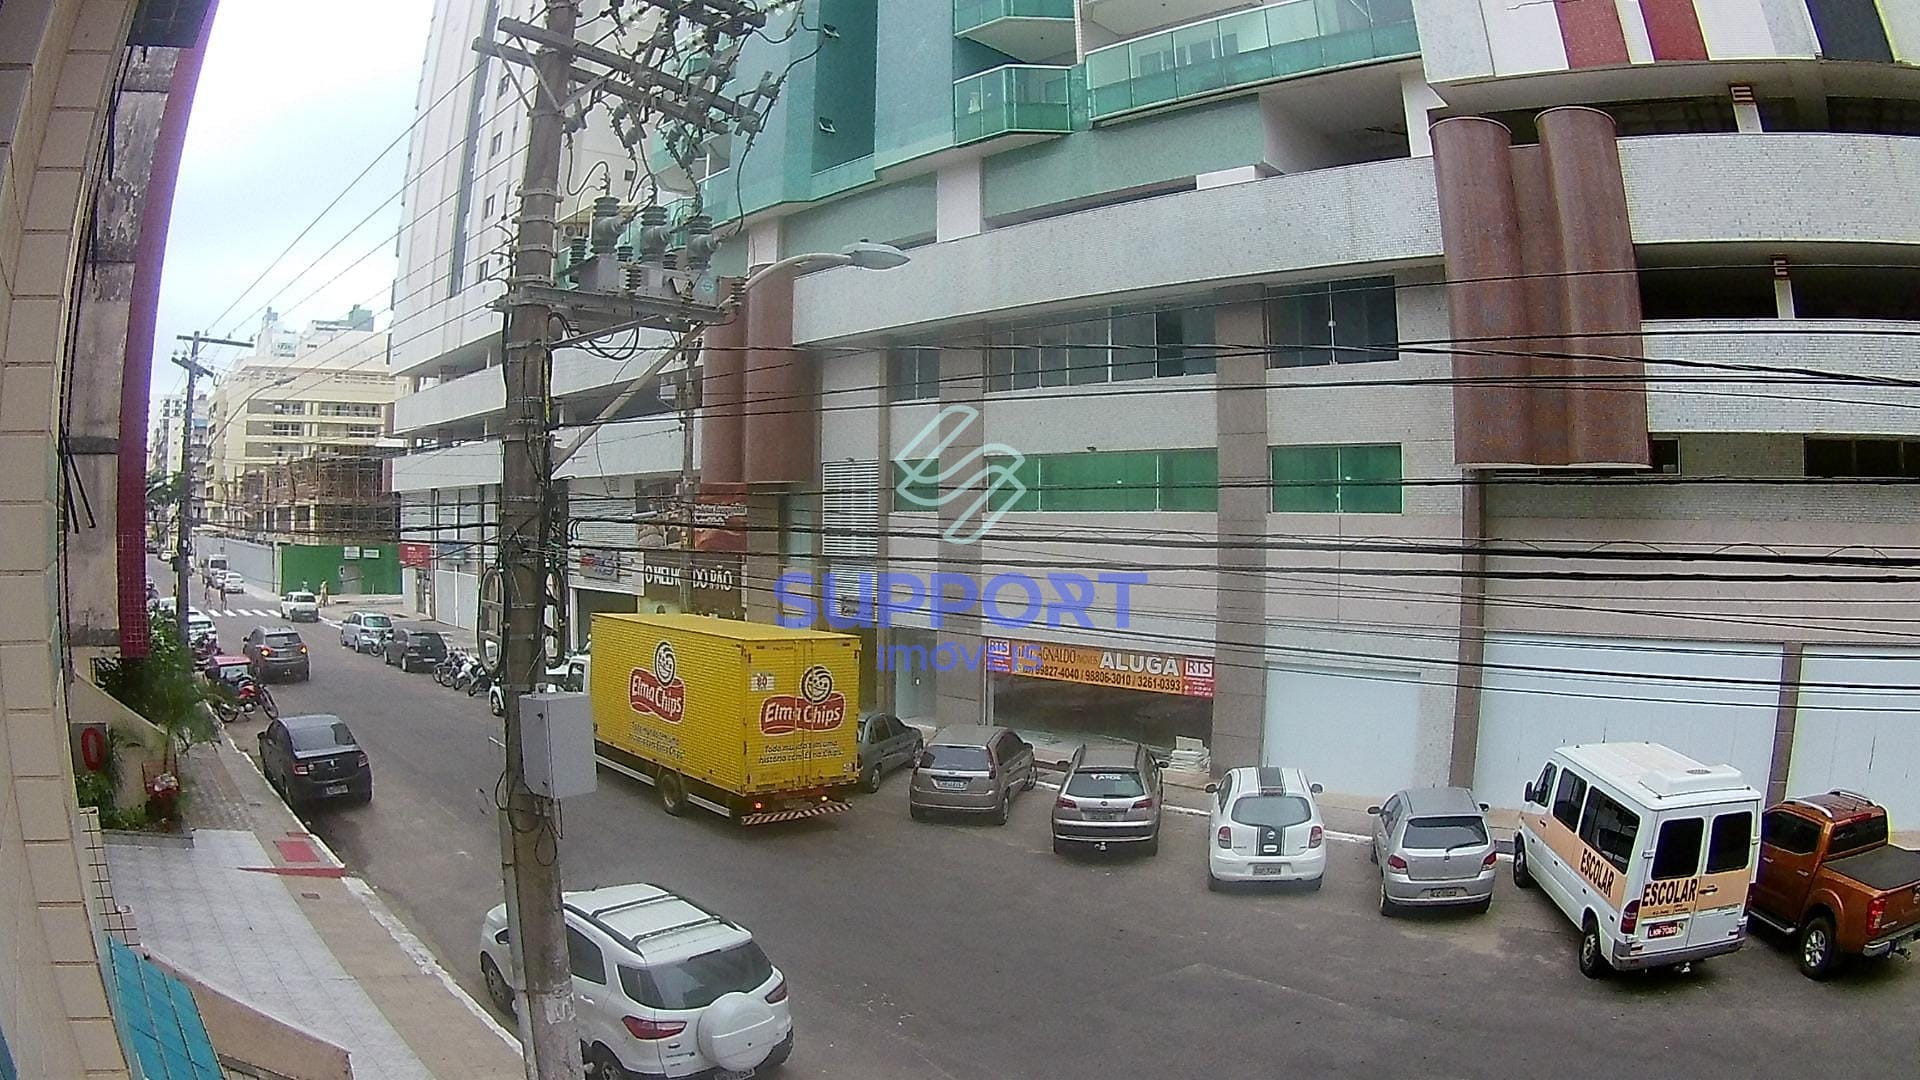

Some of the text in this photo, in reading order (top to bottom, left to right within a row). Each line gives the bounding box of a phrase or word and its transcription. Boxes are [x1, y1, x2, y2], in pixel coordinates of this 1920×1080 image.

[693, 568, 708, 588] DO
[710, 565, 733, 591] PÃO
[989, 639, 1008, 653] RTS
[1099, 651, 1180, 677] ALUGA
[1187, 660, 1211, 675] RTS
[631, 675, 682, 717] Elma Chips
[1137, 675, 1181, 691] 3261-0393
[803, 704, 841, 727] Chips
[1580, 848, 1615, 898] ESCOLAR
[1641, 879, 1698, 908] ESCOLAR
